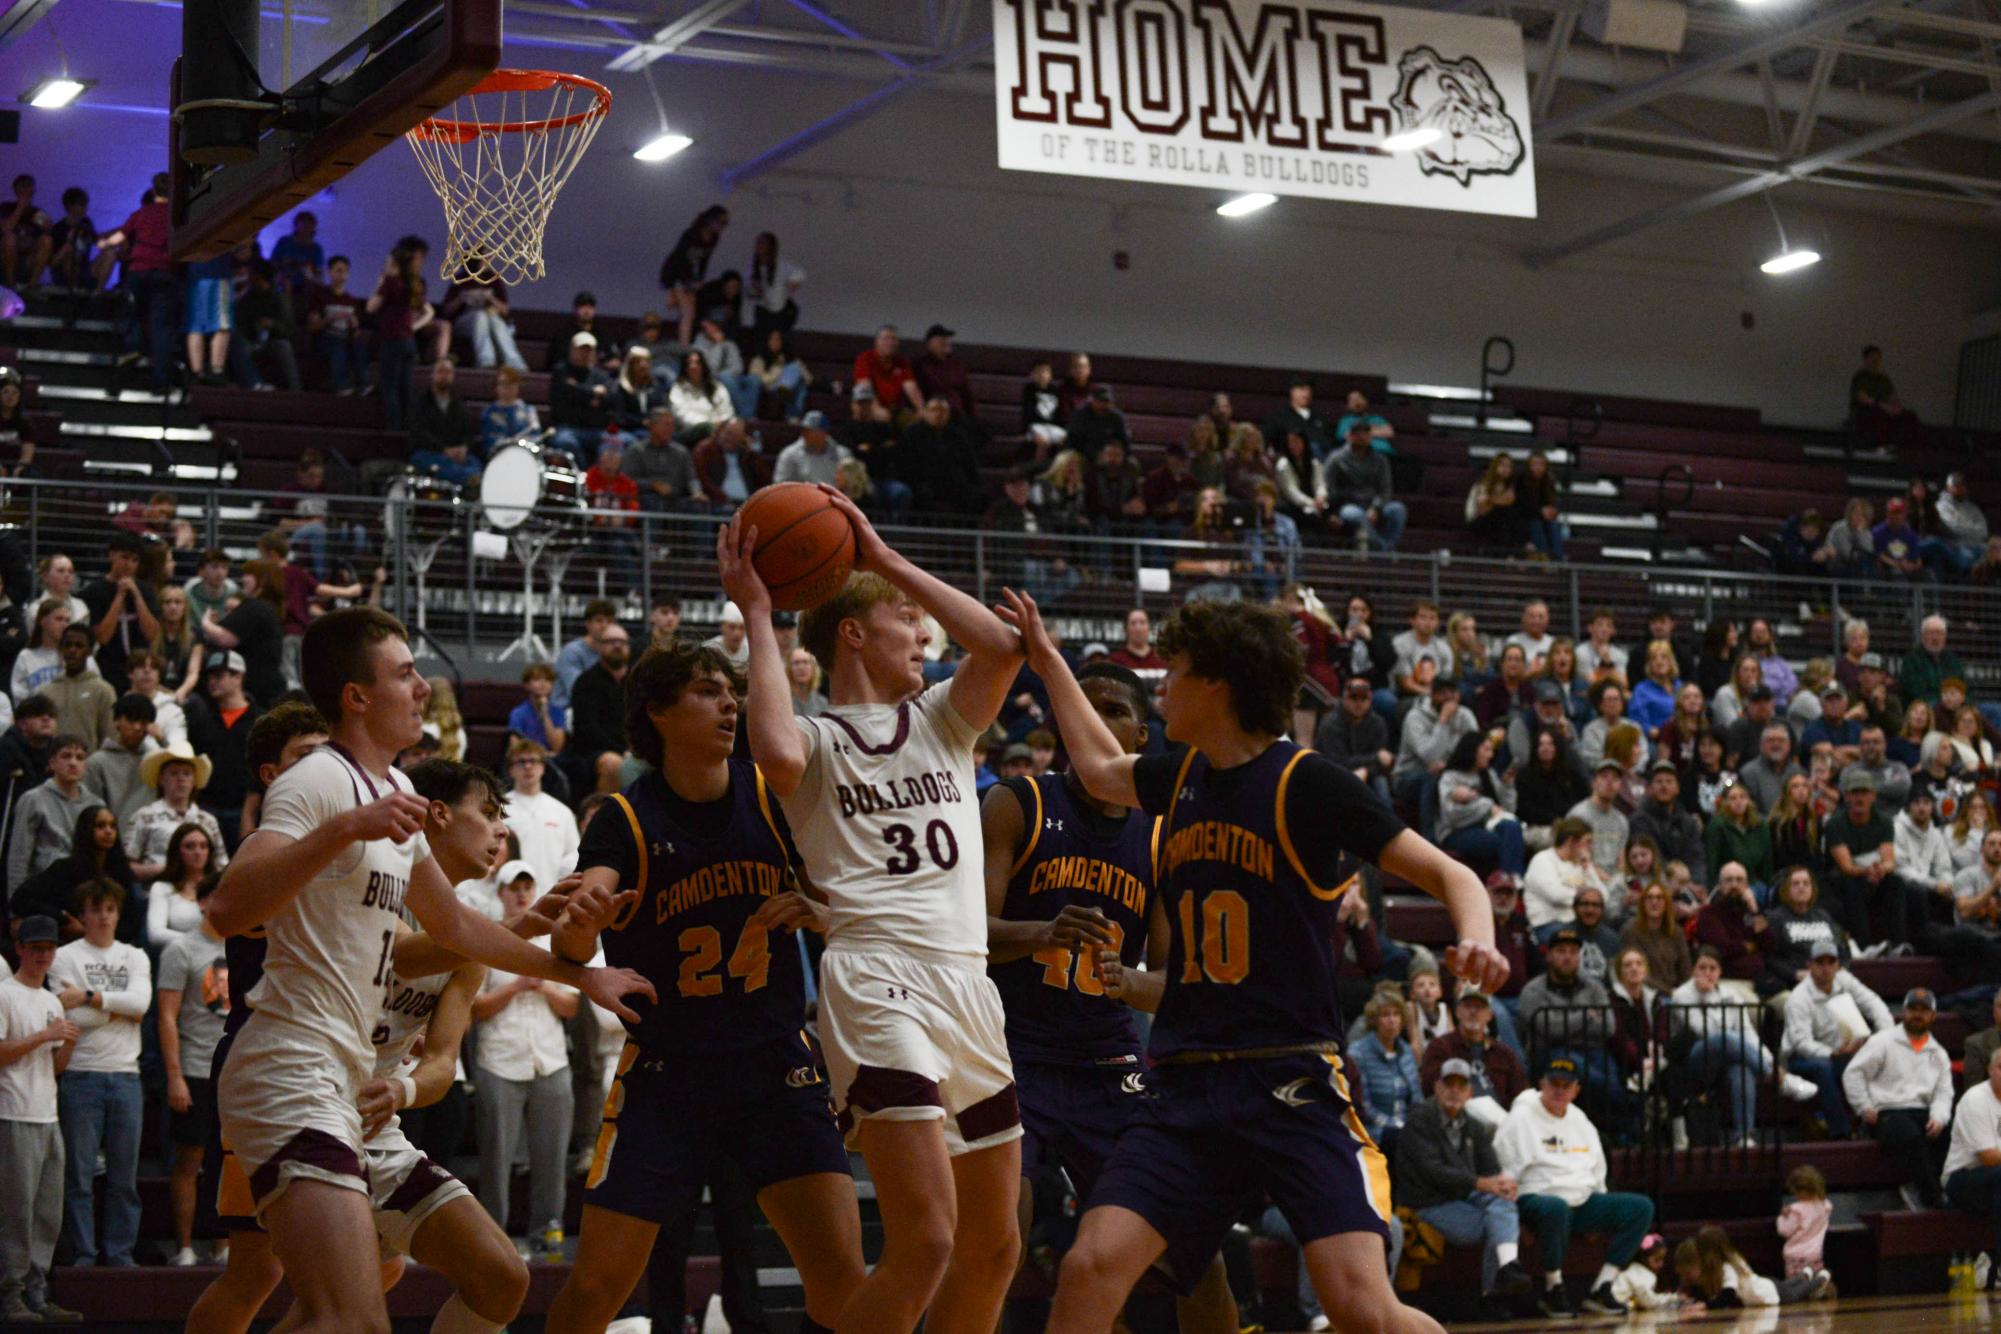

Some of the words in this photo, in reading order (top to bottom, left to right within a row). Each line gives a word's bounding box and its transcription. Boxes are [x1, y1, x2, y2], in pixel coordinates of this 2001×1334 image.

[1005, 0, 1392, 156] HOME
[1041, 133, 1072, 159] OF
[1084, 137, 1136, 165] THE
[1149, 143, 1231, 175] ROLLA
[1244, 153, 1370, 188] BULLDOGS
[836, 771, 961, 818] BULLDOGS
[882, 818, 959, 875] 30
[656, 860, 783, 927] CAMDENTON
[1028, 856, 1147, 919] CAMDENTON
[676, 914, 772, 998] 24
[1178, 889, 1250, 986] 10
